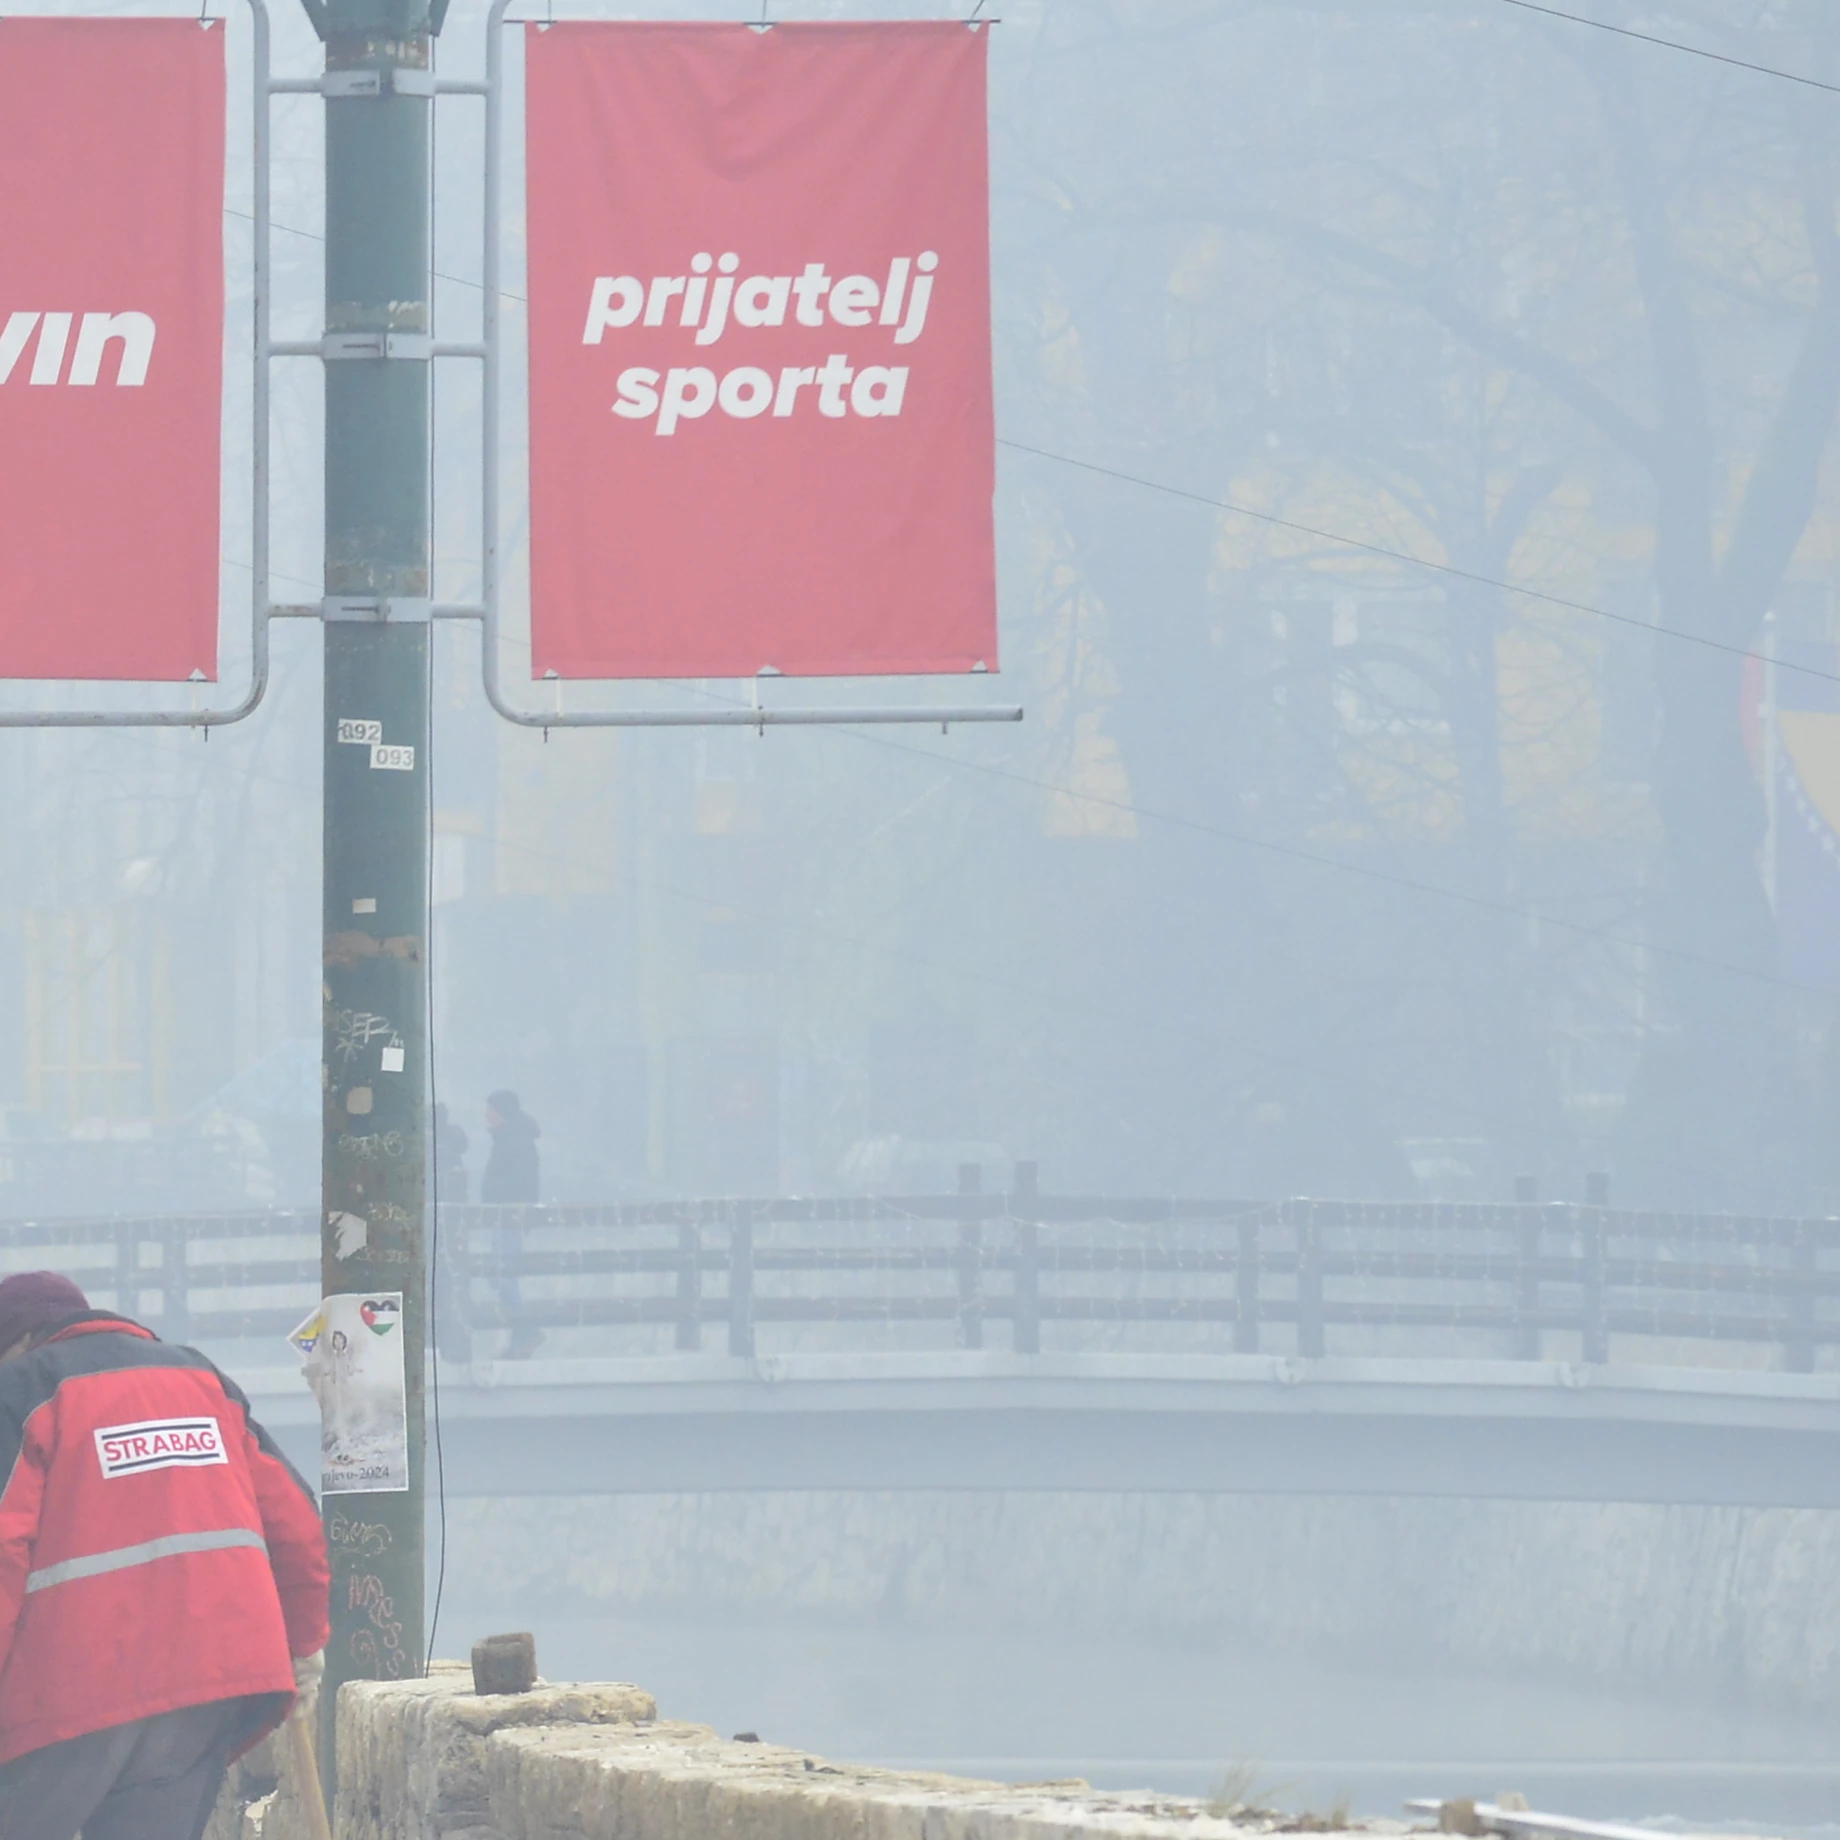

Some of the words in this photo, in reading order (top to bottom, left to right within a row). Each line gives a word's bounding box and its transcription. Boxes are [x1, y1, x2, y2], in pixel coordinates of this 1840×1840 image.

[582, 251, 939, 346] prijatelj
[611, 354, 909, 437] sporta
[376, 748, 414, 767] 093
[103, 1430, 216, 1463] STRABAG
